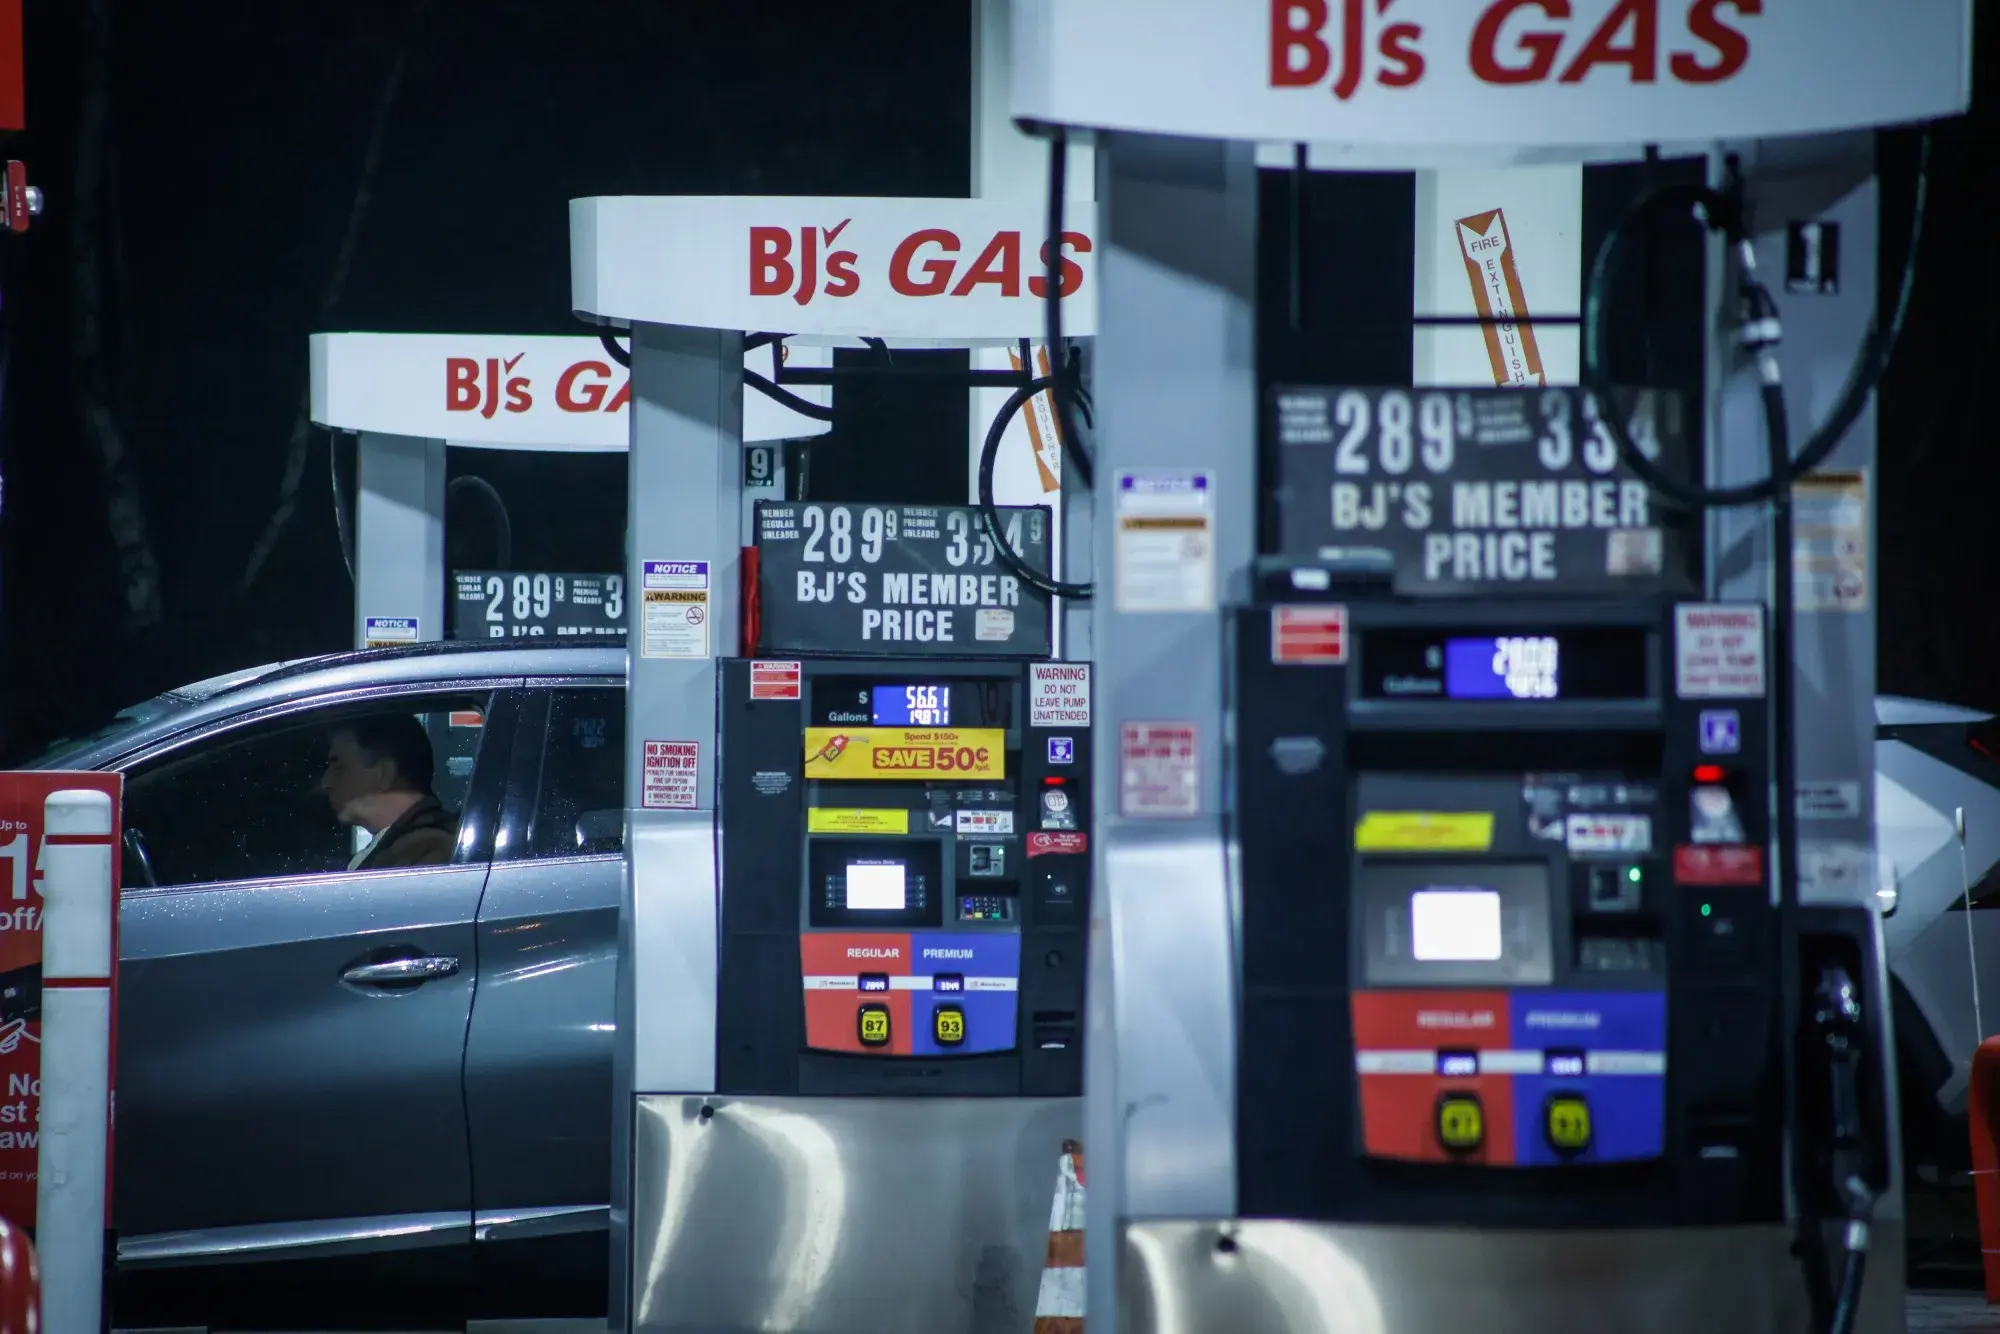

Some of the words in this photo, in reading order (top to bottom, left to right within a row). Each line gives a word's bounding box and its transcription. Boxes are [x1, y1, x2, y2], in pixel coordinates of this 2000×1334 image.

[1468, 0, 1762, 86] GAS
[1471, 236, 1500, 252] FIRE
[888, 228, 1092, 299] GAS
[1486, 258, 1526, 388] EXTINGUISH
[1335, 390, 1454, 475] 289
[751, 448, 768, 478] 9
[1332, 481, 1432, 530] BJ'S
[1452, 479, 1650, 528] MEMBER
[761, 508, 794, 518] MEMBER
[762, 519, 794, 528] REGULAR
[903, 518, 936, 527] PREMIUM
[762, 530, 799, 539] UNLEADED
[803, 505, 883, 563] 289
[903, 529, 940, 538] UNLEADED
[1424, 533, 1557, 580] PRICE
[654, 564, 698, 573] NOTICE
[797, 570, 867, 604] BJ'S
[883, 573, 1019, 606] MEMBER
[486, 574, 550, 621] 289
[653, 592, 707, 602] WARNING
[374, 619, 409, 628] NOTICE
[862, 610, 954, 641] PRICE
[1036, 668, 1086, 681] WARNING
[1044, 684, 1057, 694] DO
[1060, 684, 1077, 694] NOT
[859, 691, 868, 704] $
[1035, 697, 1060, 708] LEAVE
[1063, 697, 1086, 708] PUMP
[828, 711, 868, 722] Gallons
[1034, 710, 1088, 721] UNATTENDED
[904, 732, 932, 742] Spend
[647, 744, 658, 755] NO
[660, 744, 696, 757] SMOKING
[646, 756, 681, 768] IGNITION
[682, 757, 696, 768] OFF
[875, 749, 933, 768] SAVE
[15, 821, 28, 830] to
[847, 948, 900, 959] REGULAR
[923, 948, 974, 960] PREMIUM
[864, 1020, 885, 1032] 87
[940, 1020, 961, 1033] 93
